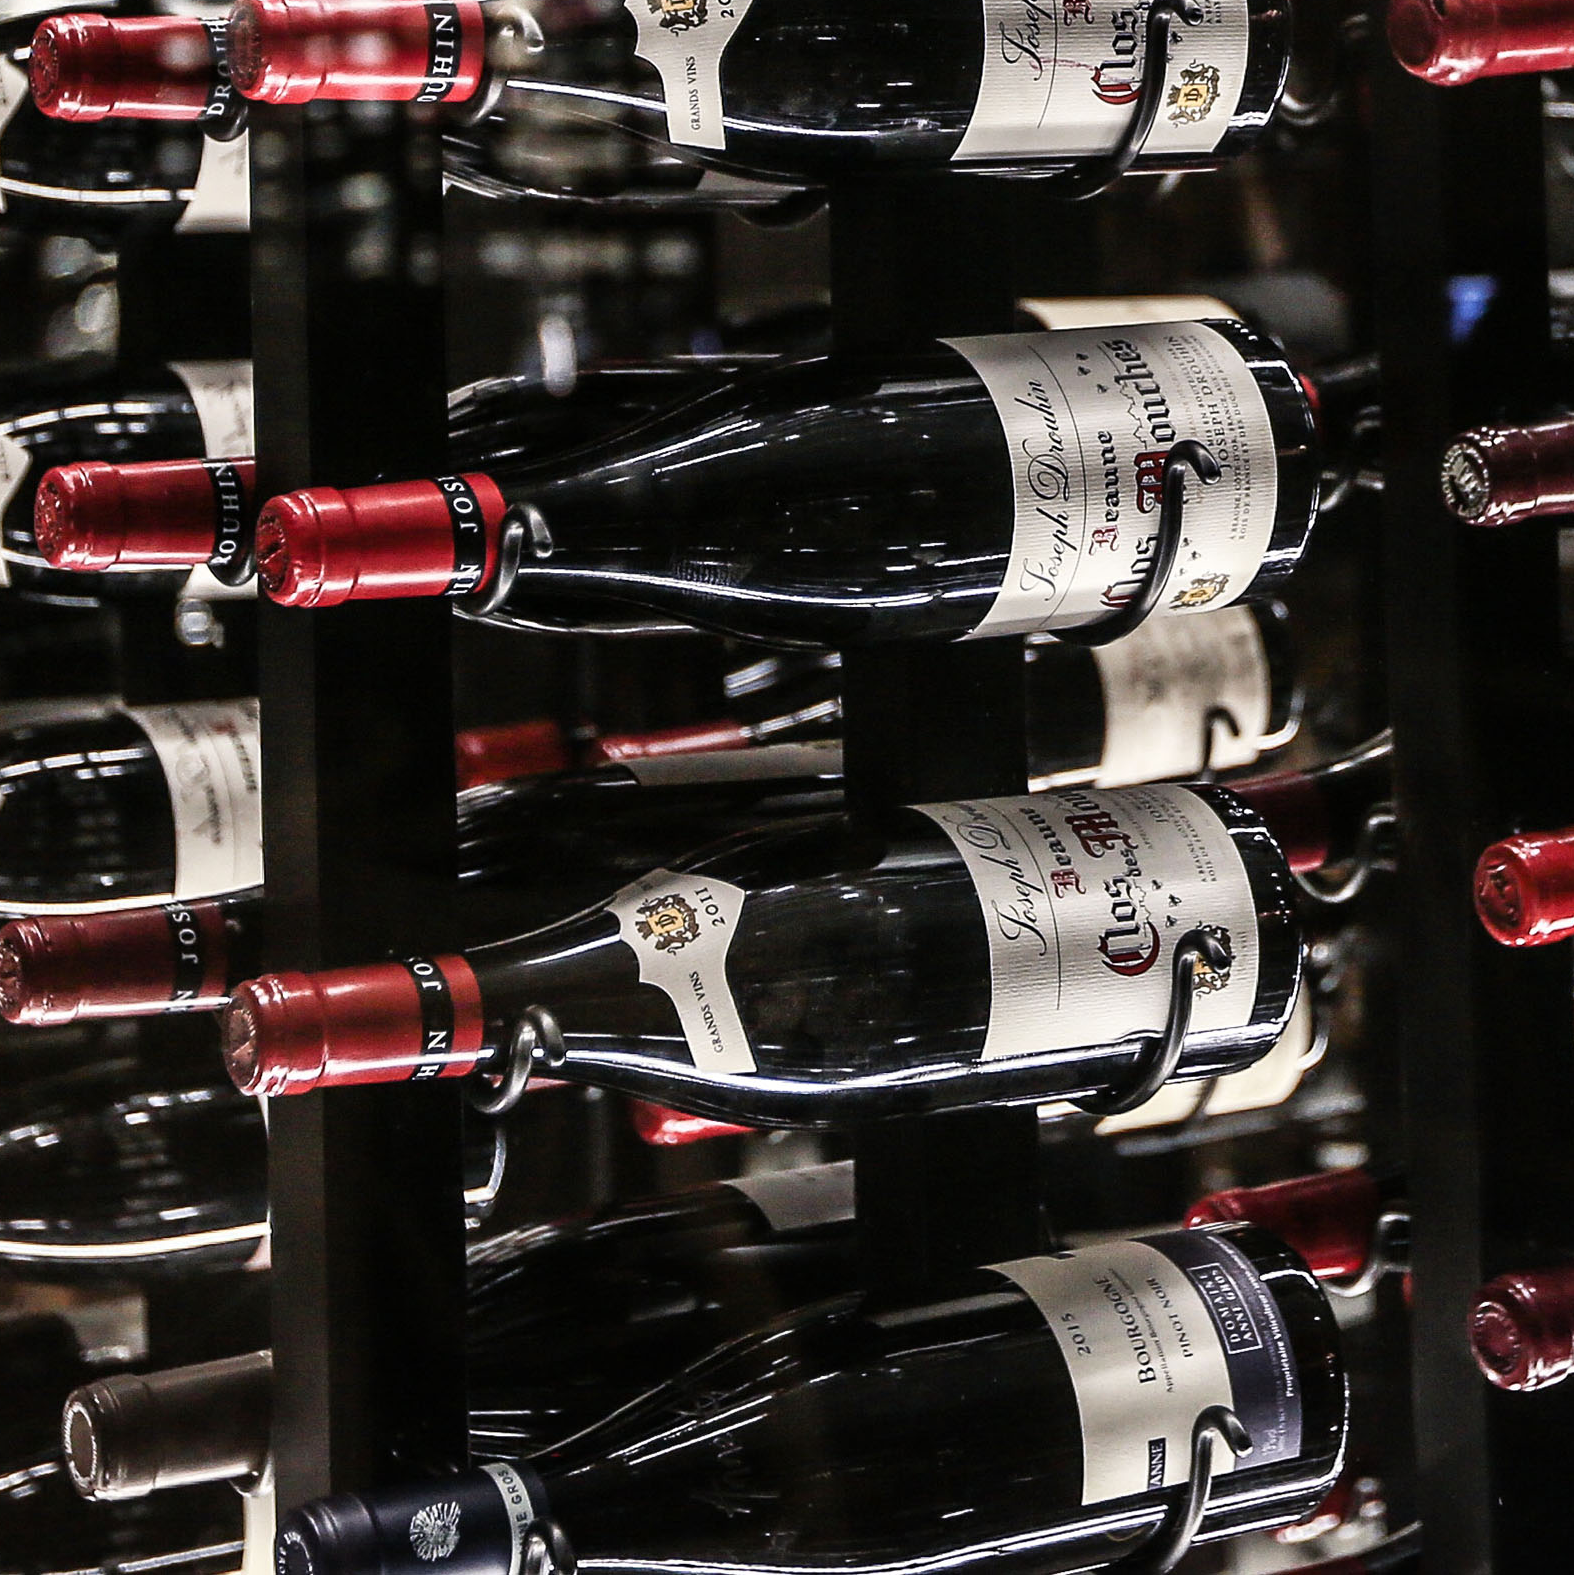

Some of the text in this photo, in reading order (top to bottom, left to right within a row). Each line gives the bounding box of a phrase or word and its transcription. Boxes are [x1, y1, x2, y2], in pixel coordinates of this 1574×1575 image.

[204, 21, 232, 116] DROUH
[1089, 7, 1143, 106] Clos
[685, 56, 701, 131] GRANDS VINS
[1168, 335, 1213, 395] DROUHIN
[1102, 339, 1178, 513] Mouches
[1200, 412, 1208, 424] EN
[1206, 429, 1215, 447] MIS
[1210, 403, 1232, 470] JOSEPH
[1238, 419, 1247, 438] DES
[1241, 442, 1249, 454] ET
[1014, 378, 1076, 601] Joseph Drouhin
[1087, 430, 1121, 556] Beaune
[1242, 502, 1250, 514] DE
[1243, 459, 1251, 497] FRANCE
[1018, 806, 1087, 899] Beaune
[1117, 848, 1143, 878] des
[695, 886, 726, 928] 2011
[979, 853, 1048, 956] Joseph
[1097, 876, 1161, 977] Clos
[688, 970, 725, 1054] GRANDS VINS
[1061, 1312, 1092, 1356] 2015
[1095, 1275, 1159, 1384] BOURGOGNE
[1145, 1276, 1195, 1358] PINOT NOIR
[1198, 1273, 1242, 1344] DOMAINE
[1236, 1307, 1254, 1342] ANNE
[1258, 1294, 1283, 1340] Viticulteur
[1277, 1341, 1295, 1397] Propriétaire
[497, 1469, 522, 1506] GROS
[1150, 1442, 1164, 1487] ANNE
